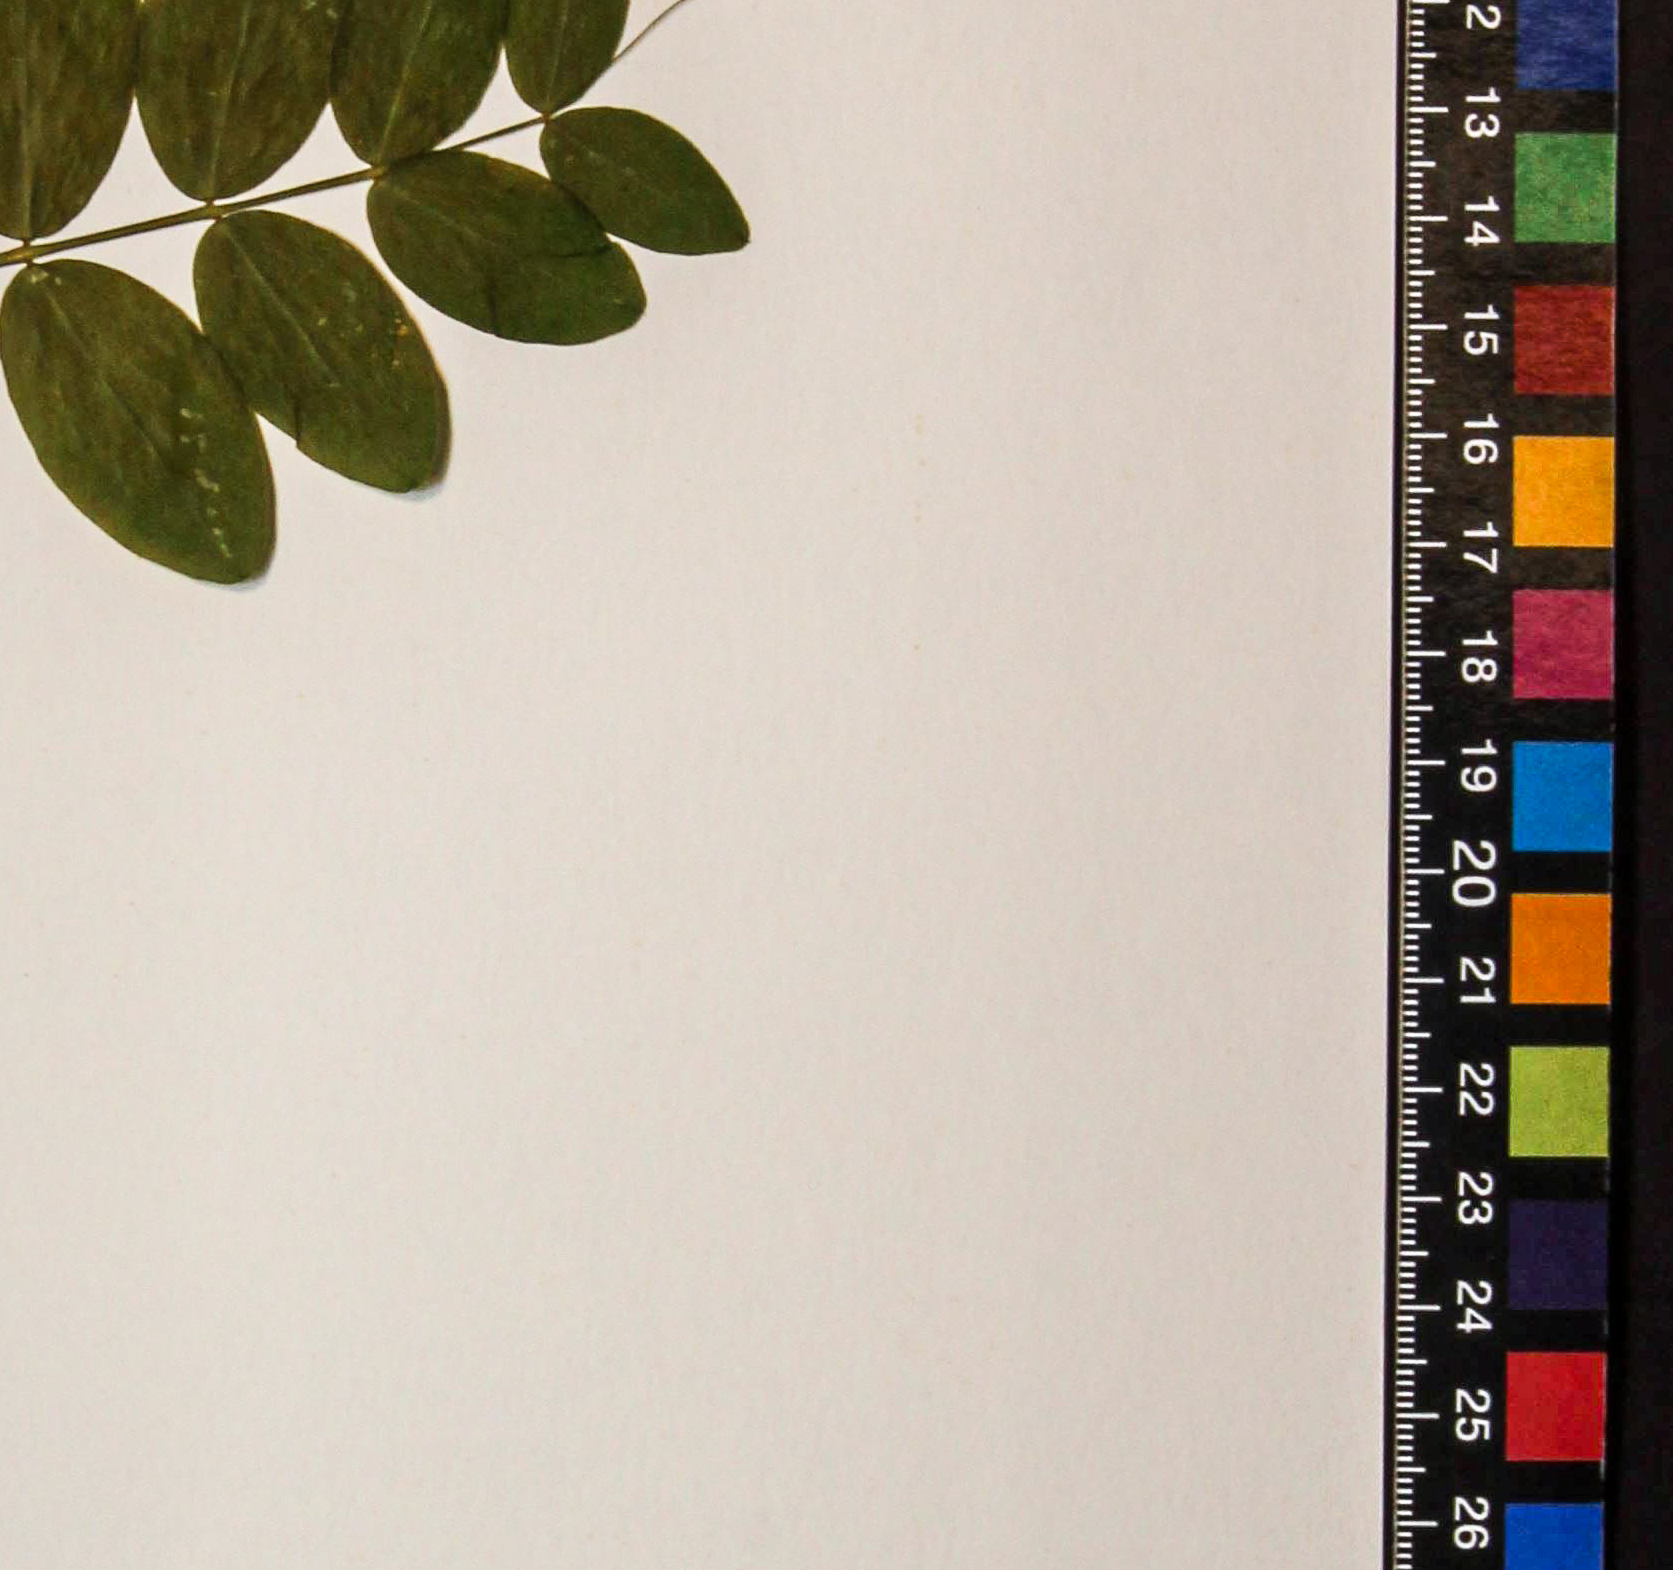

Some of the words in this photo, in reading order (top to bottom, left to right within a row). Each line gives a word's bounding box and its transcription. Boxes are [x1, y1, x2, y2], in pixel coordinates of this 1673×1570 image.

[1464, 86, 1502, 139] 13
[1463, 195, 1501, 247] 14
[1463, 304, 1500, 356] 15
[1463, 413, 1500, 465] 16
[1463, 521, 1500, 574] 17
[1461, 629, 1499, 683] 18
[1460, 738, 1498, 793] 19
[1452, 839, 1497, 908] 20
[1459, 956, 1497, 1004] 21
[1459, 1062, 1495, 1116] 22
[1457, 1171, 1494, 1225] 23
[1456, 1280, 1493, 1334] 24
[1455, 1388, 1491, 1442] 25
[1453, 1496, 1490, 1550] 26
